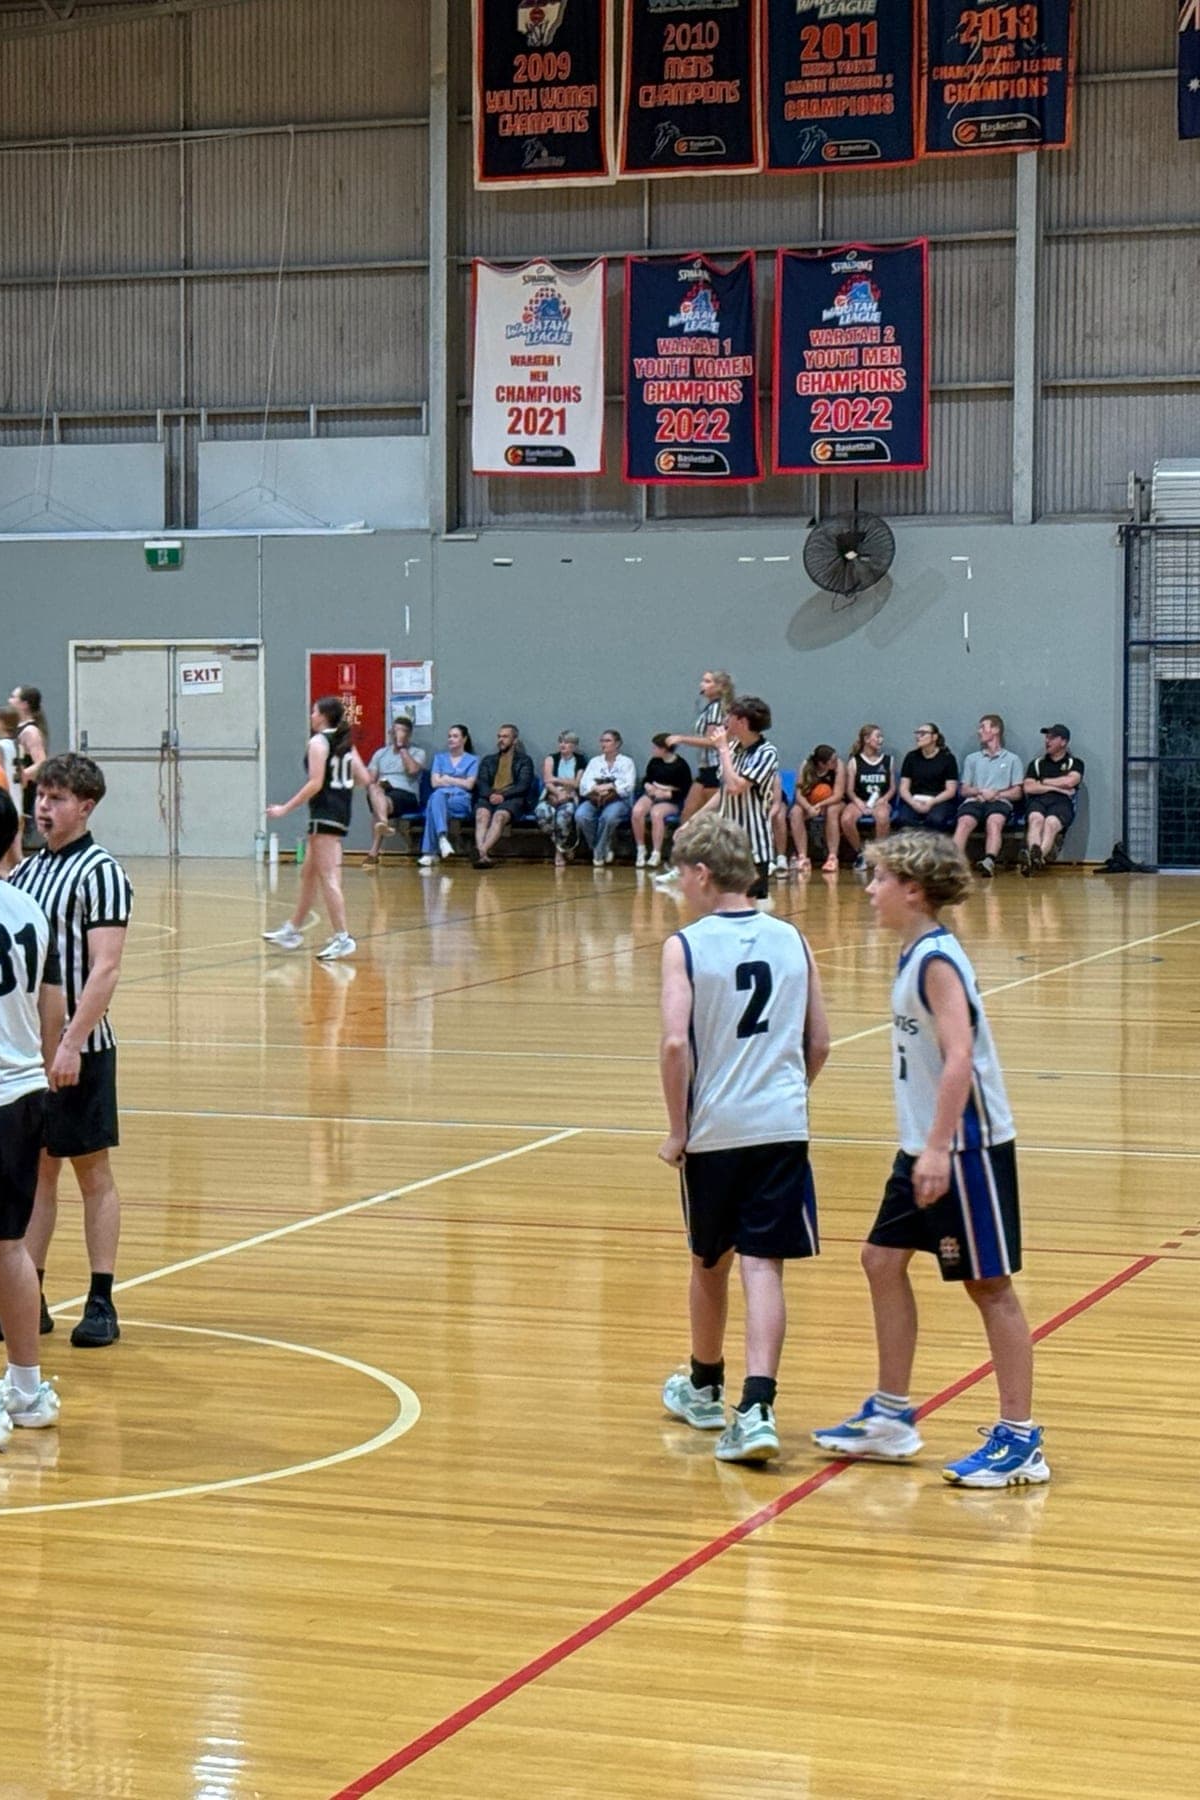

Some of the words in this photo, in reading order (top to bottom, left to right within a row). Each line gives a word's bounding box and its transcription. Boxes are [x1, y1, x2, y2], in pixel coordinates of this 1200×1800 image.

[662, 20, 720, 52] 2010
[960, 4, 1038, 44] 2013
[800, 20, 878, 60] 2011
[513, 51, 571, 83] 2009
[486, 88, 538, 113] YOUTH
[539, 84, 597, 110] WOMEN
[639, 80, 740, 108] CHAMPIONS
[943, 76, 1048, 104] CHAMPIONS
[784, 93, 894, 120] CHAMPIONS
[499, 110, 589, 136] CHAMPIONS
[839, 312, 882, 326] LEAGUE
[524, 330, 573, 346] LEAGUE
[722, 338, 732, 356] 1
[809, 327, 880, 346] WARATAH
[883, 325, 895, 344] 2
[633, 357, 690, 379] YOUTH
[803, 350, 858, 369] YOUTH
[862, 345, 902, 367] MEN
[495, 385, 583, 403] CHAMPIONS
[795, 367, 907, 396] CHAMPIONS
[507, 406, 567, 435] 2021
[655, 408, 730, 443] 2022
[810, 396, 893, 433] 2022
[183, 668, 221, 683] EXIT
[735, 961, 773, 1039] 2
